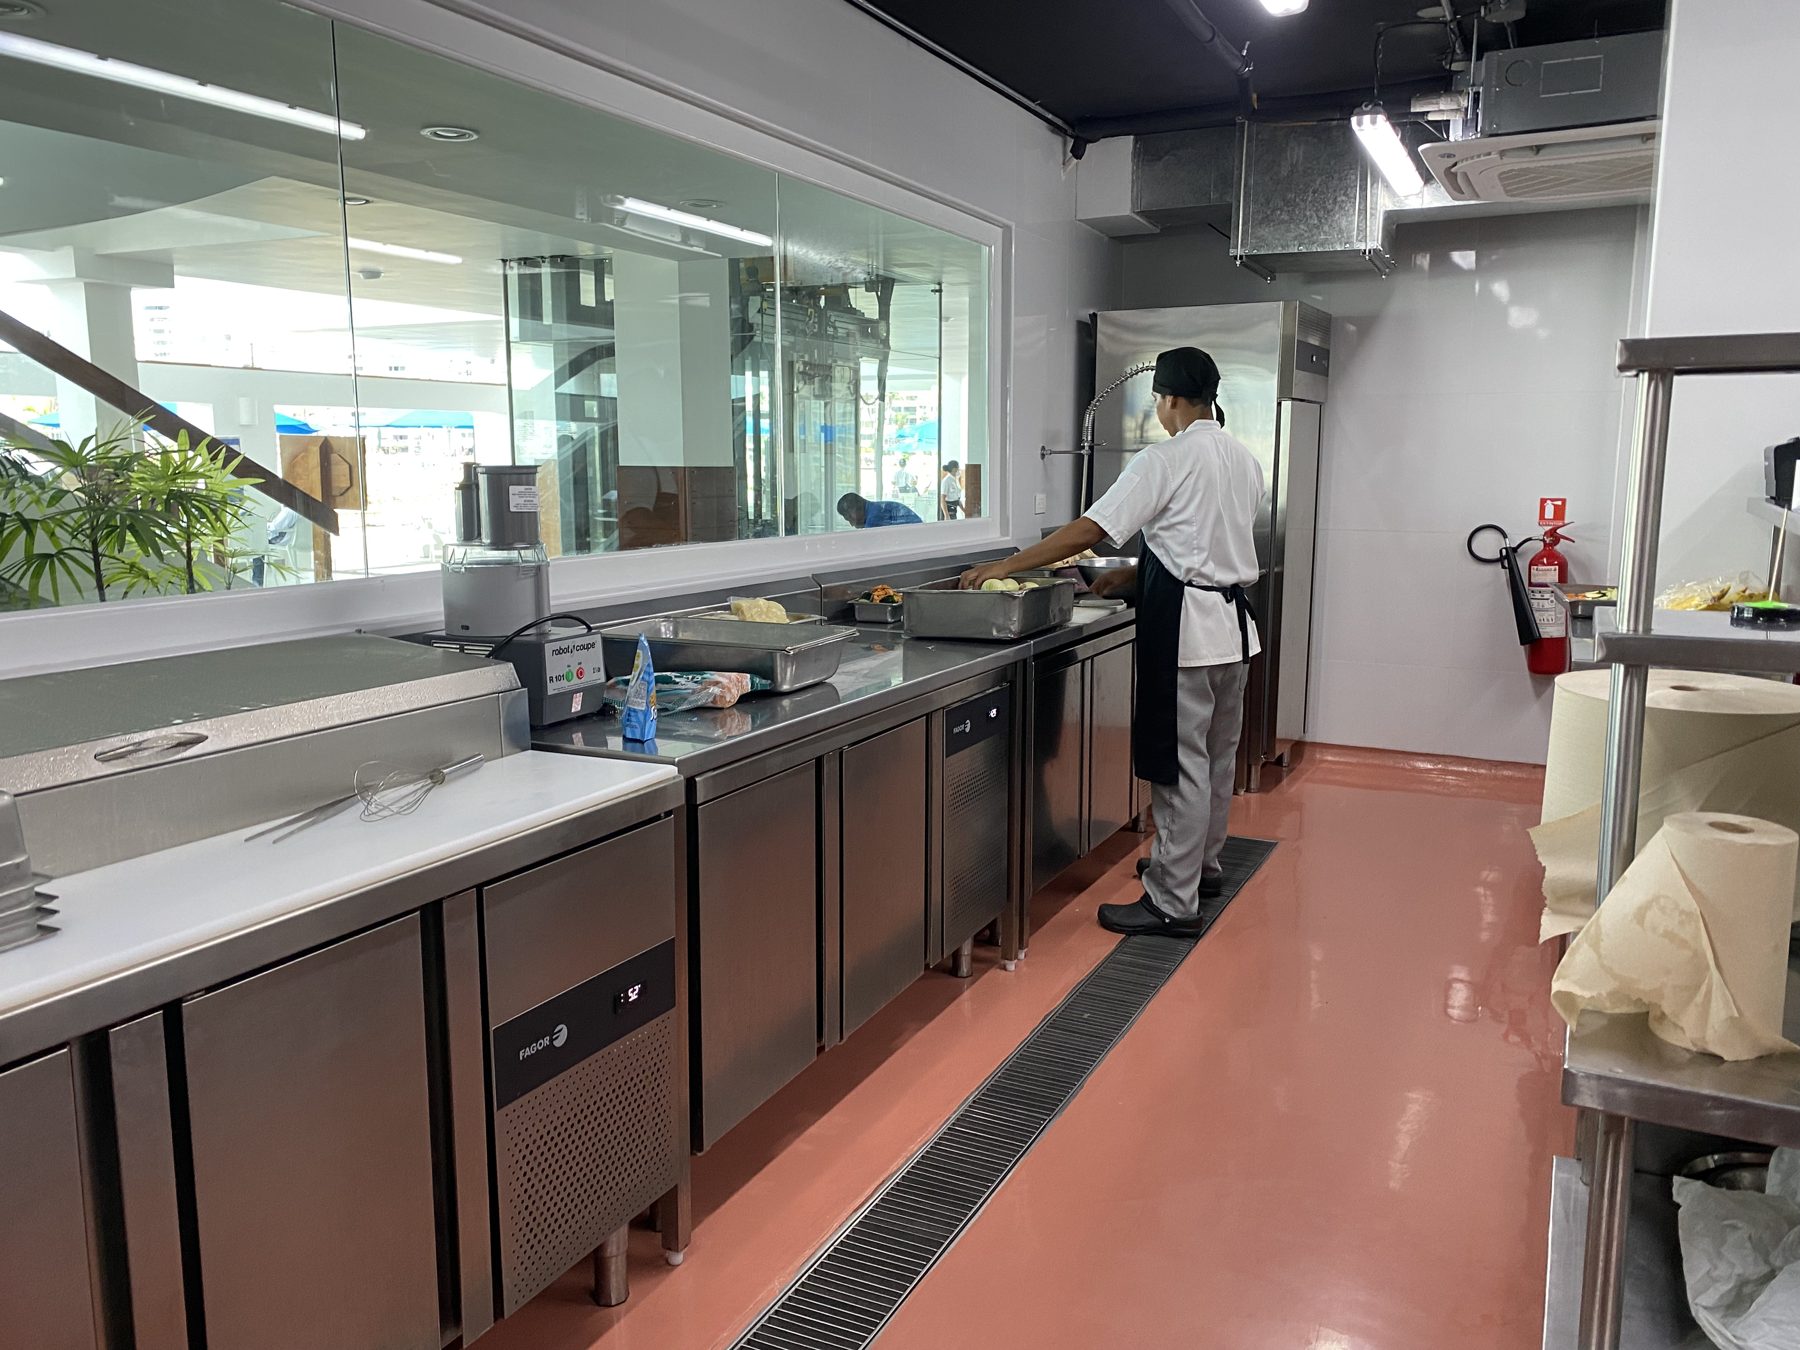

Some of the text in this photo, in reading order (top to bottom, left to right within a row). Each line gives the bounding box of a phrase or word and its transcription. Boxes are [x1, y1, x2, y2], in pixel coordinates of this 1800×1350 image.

[552, 641, 596, 656] robot coupe
[555, 673, 565, 682] 101
[519, 1036, 550, 1061] FAGOR
